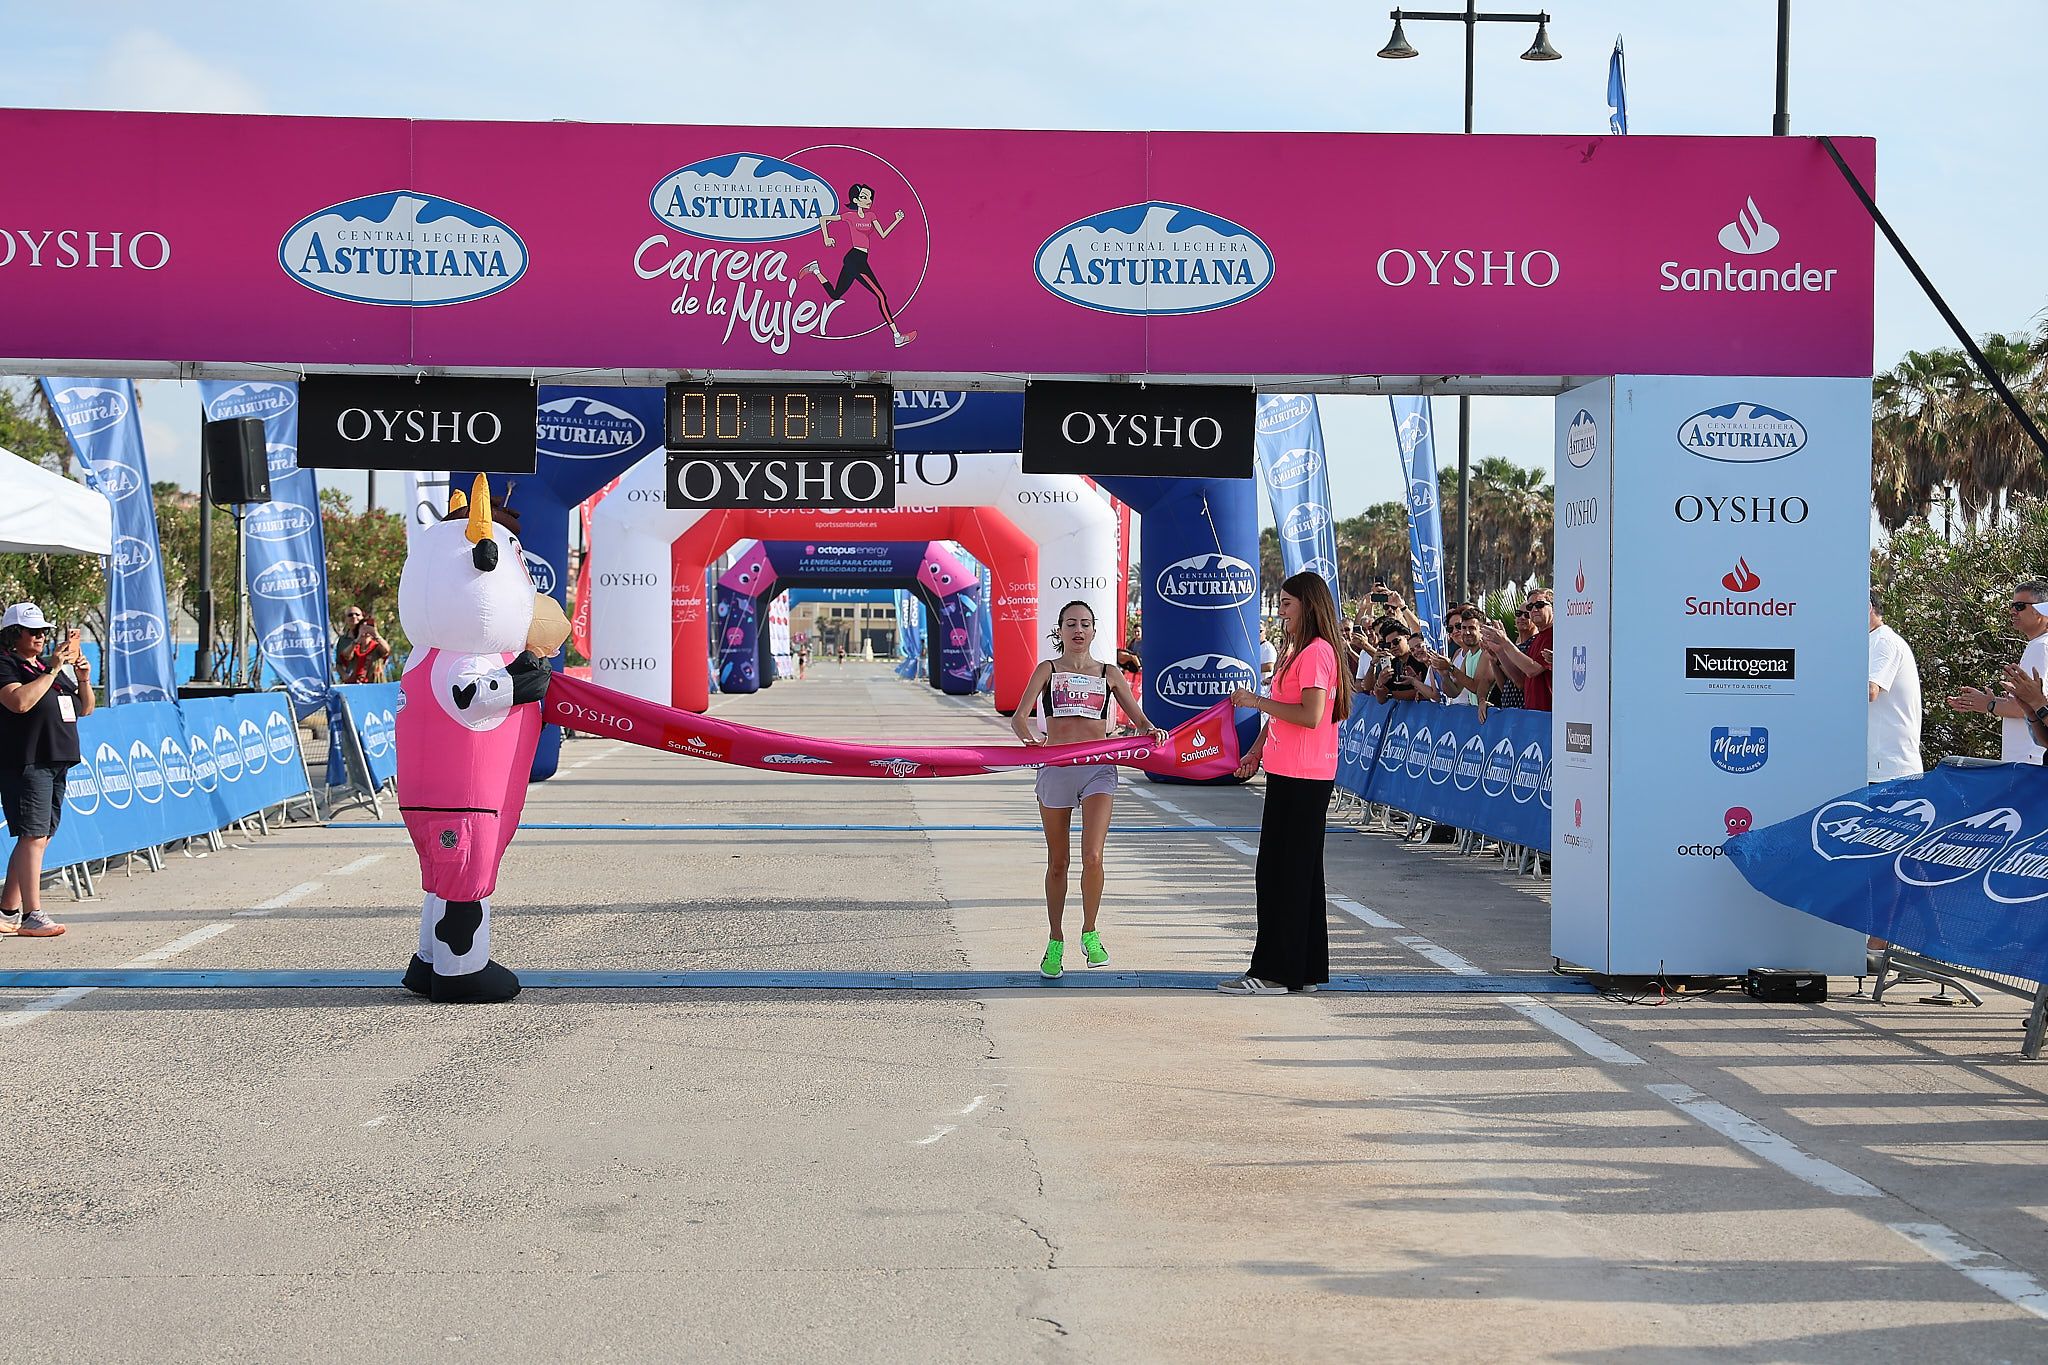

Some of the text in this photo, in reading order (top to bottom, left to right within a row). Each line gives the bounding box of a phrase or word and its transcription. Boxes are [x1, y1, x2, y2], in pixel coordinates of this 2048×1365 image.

[694, 183, 818, 194] CENTRAL LECHERA
[664, 184, 823, 220] ASTURIANA
[337, 229, 501, 244] CENTRAL LECHERA
[1090, 241, 1248, 253] CENTRAL LECHERA
[299, 231, 510, 278] ASTURIANA
[633, 234, 788, 283] Carrera
[1053, 243, 1257, 286] ASTURIANA
[1376, 249, 1561, 288] OYSHO
[1660, 261, 1838, 292] Santander
[671, 279, 845, 355] de la Mujer
[337, 408, 502, 446] OYSHO
[540, 416, 633, 428] CENTRAL LECHERA
[682, 393, 877, 440] 00:18:17
[1061, 411, 1223, 450] OYSHO
[1687, 424, 1798, 449] ASTURIANA
[677, 460, 885, 502] OYSHO
[1018, 491, 1079, 504] OYSHO
[1565, 497, 1598, 528] OYSHO
[1674, 495, 1809, 524] OYSHO
[815, 521, 878, 529] sportssantander.es
[817, 546, 889, 557] octopus energy
[600, 573, 658, 587] OYSHO
[1008, 582, 1036, 591] Sports
[1050, 575, 1107, 590] OYSHO
[1163, 574, 1253, 596] ASTURIANA
[1685, 596, 1797, 617] Santander
[600, 657, 657, 671] OYSHO
[1693, 654, 1788, 676] Neutrogena
[1069, 691, 1089, 699] 016
[557, 701, 633, 732] OYSHO
[668, 739, 723, 759] Santander
[1567, 728, 1591, 750] Neutrogena
[1713, 736, 1766, 761] Marlene
[1181, 745, 1220, 763] Santander
[1746, 761, 1761, 771] ALPES
[1905, 831, 1994, 870] ASTURIANA
